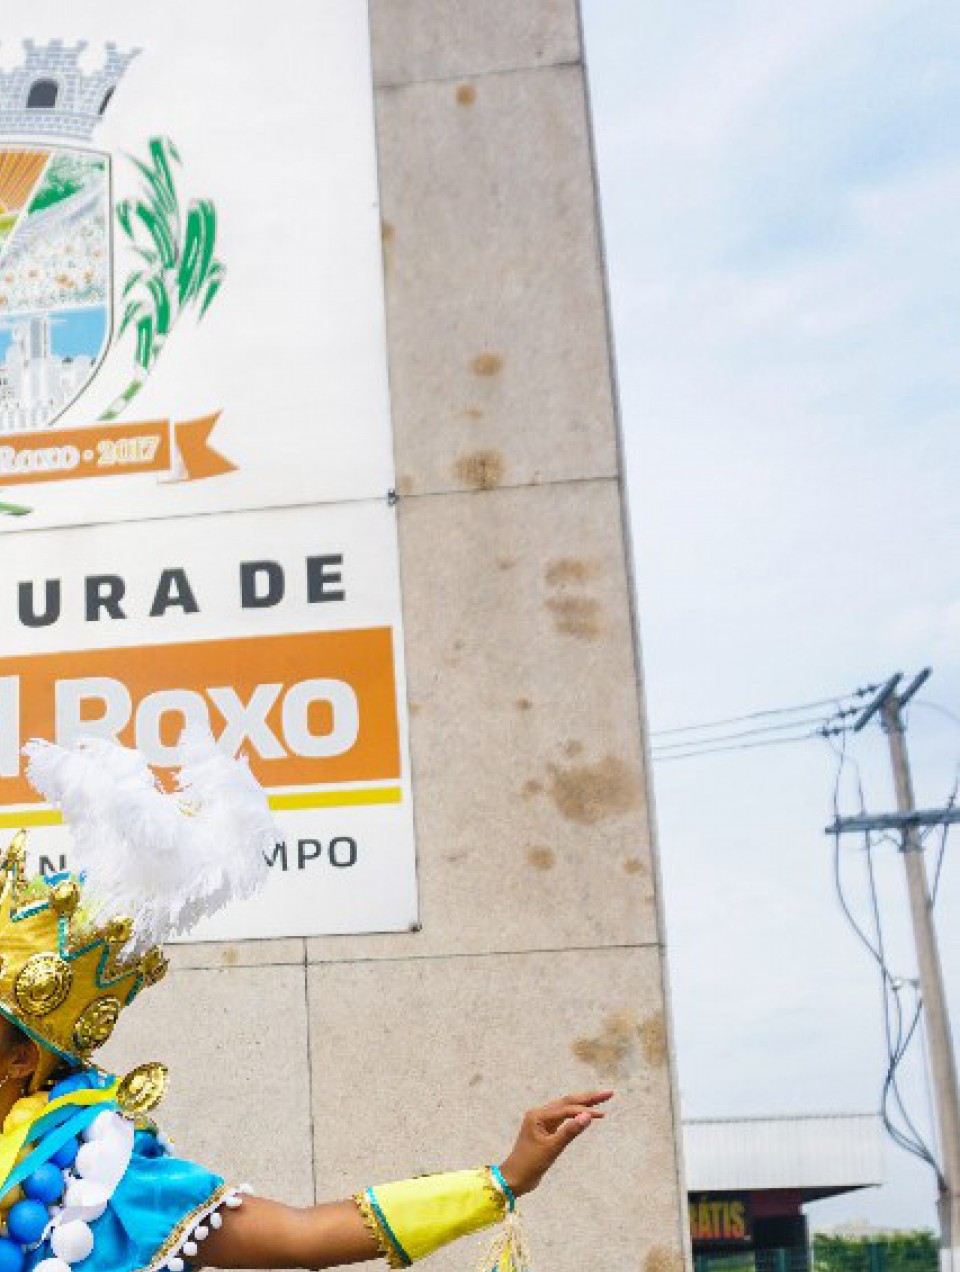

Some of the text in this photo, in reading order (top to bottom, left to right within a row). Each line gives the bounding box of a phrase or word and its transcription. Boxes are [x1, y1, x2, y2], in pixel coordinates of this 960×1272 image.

[239, 553, 346, 609] DE
[53, 676, 360, 770] Roxo
[262, 836, 358, 872] MPO
